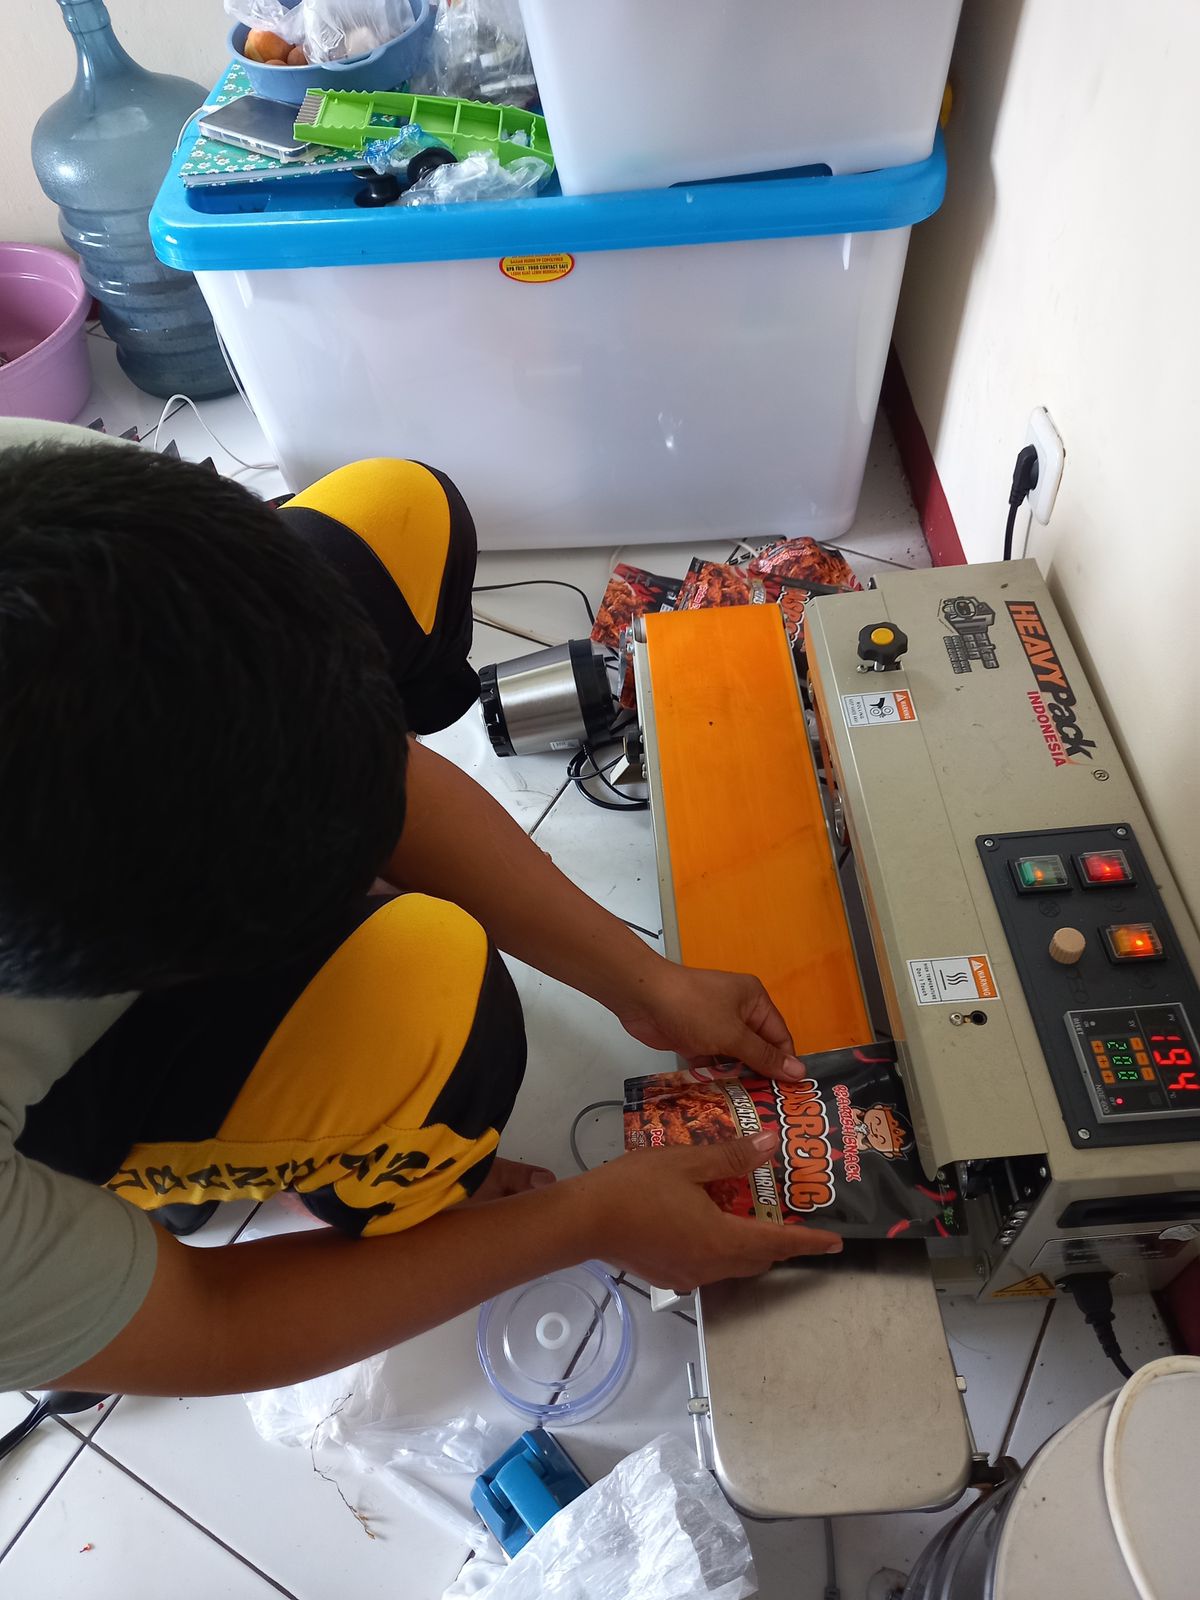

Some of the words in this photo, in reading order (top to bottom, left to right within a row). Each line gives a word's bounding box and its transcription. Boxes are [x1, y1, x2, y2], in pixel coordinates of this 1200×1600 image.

[1027, 690, 1067, 767] INDONESIA
[920, 982, 928, 997] Touch
[977, 970, 991, 996] WARNING
[1106, 1041, 1138, 1080] 200
[1150, 1035, 1200, 1090] 194
[774, 1079, 834, 1211] BASRENG
[843, 1137, 861, 1183] SNACK
[753, 1165, 778, 1206] MIRING
